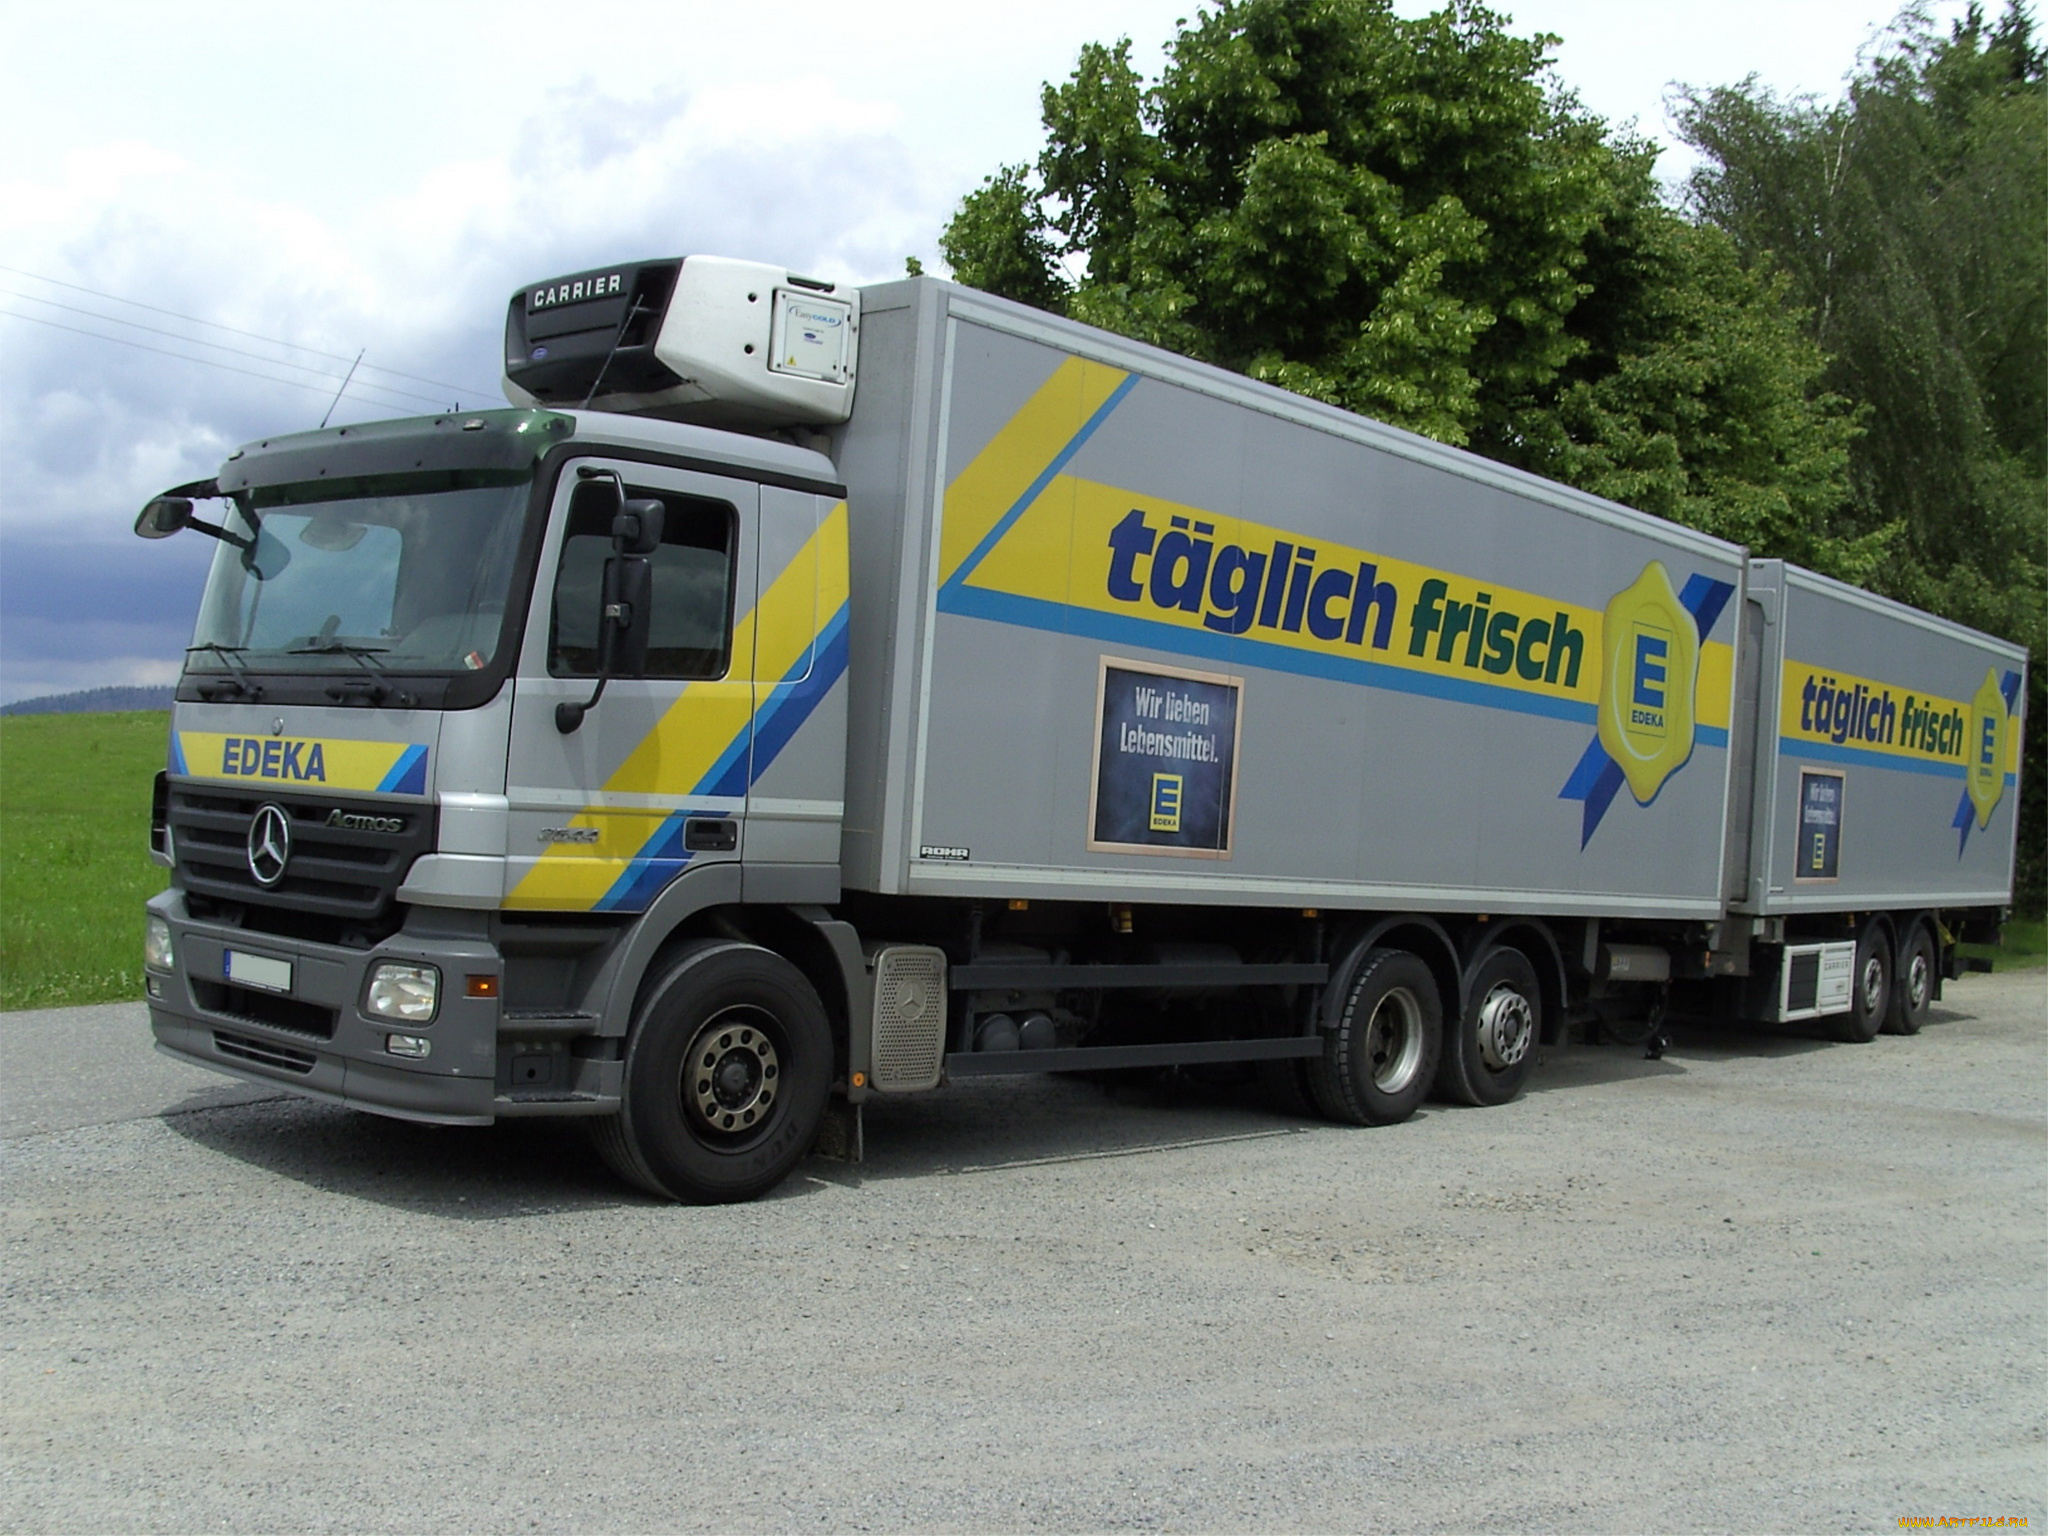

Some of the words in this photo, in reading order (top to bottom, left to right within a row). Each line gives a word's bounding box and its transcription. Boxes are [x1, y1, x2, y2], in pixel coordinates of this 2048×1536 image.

[534, 274, 620, 307] CARRIER
[1107, 509, 1397, 650] täglich
[1408, 579, 1583, 688] frisch
[1136, 687, 1162, 718] Wir
[1165, 691, 1209, 725] lieben
[1632, 710, 1664, 728] EDEKA
[1801, 675, 1896, 744] täglich
[1900, 696, 1963, 756] frisch
[222, 738, 326, 782] EDEKA
[1120, 722, 1218, 763] Lebensmittel.
[1153, 817, 1177, 826] EDEKA
